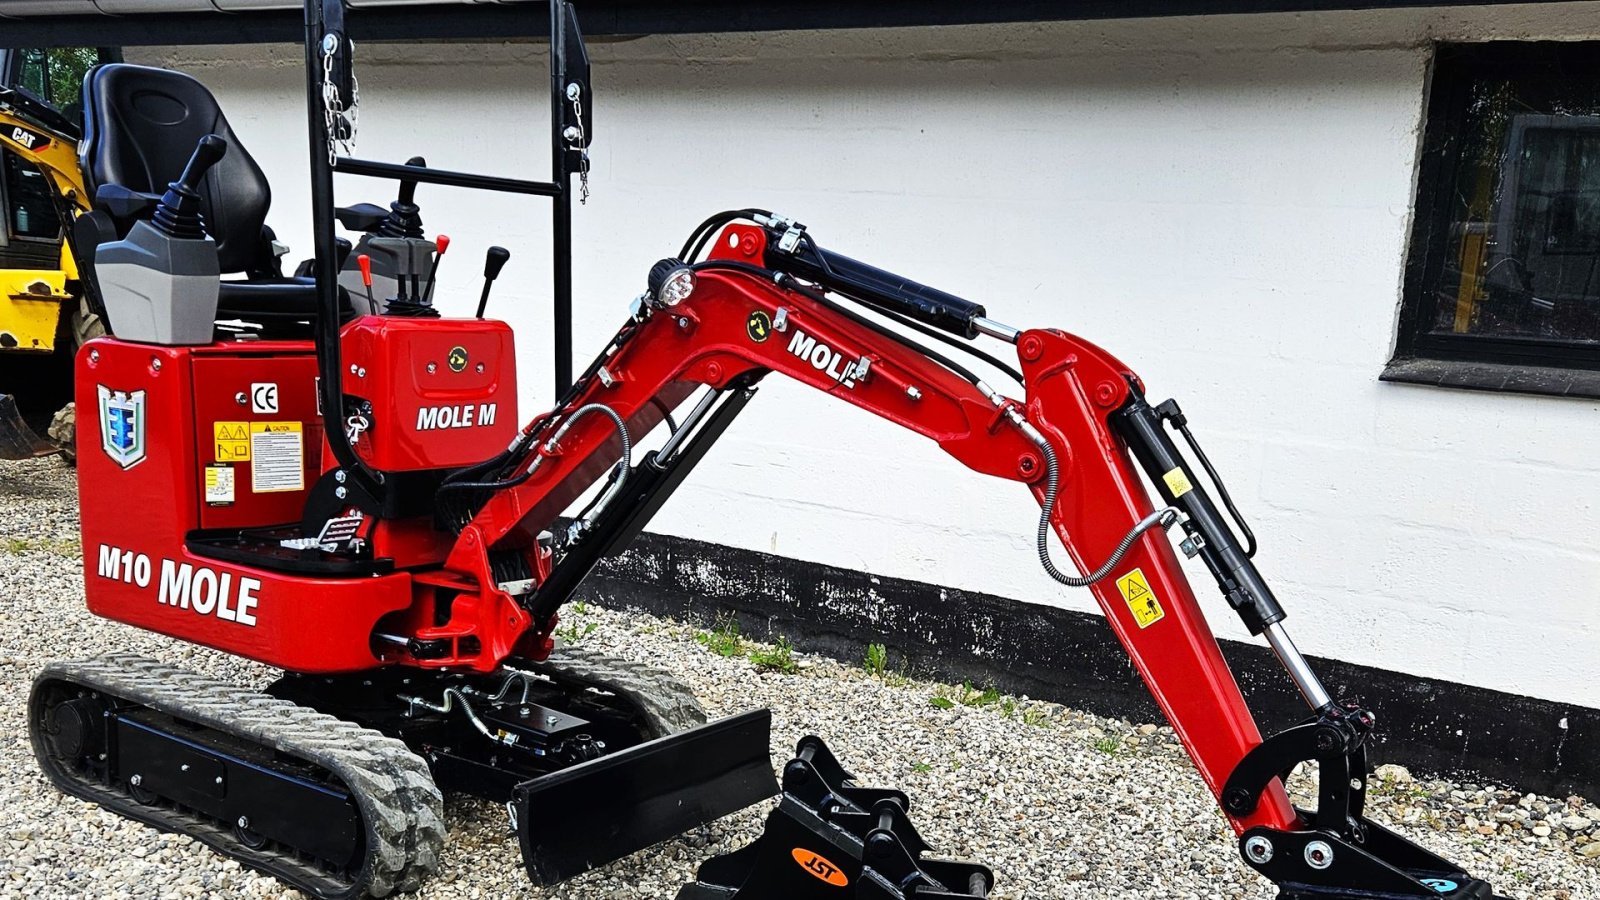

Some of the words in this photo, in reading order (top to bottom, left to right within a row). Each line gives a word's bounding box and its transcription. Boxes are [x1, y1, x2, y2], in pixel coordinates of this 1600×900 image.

[12, 127, 36, 148] CAT
[787, 330, 857, 389] MOLE
[254, 386, 277, 410] CE
[416, 404, 475, 430] MOLE
[477, 403, 497, 426] M
[98, 544, 151, 588] M10
[158, 558, 262, 627] MOLE
[804, 857, 838, 879] JST
